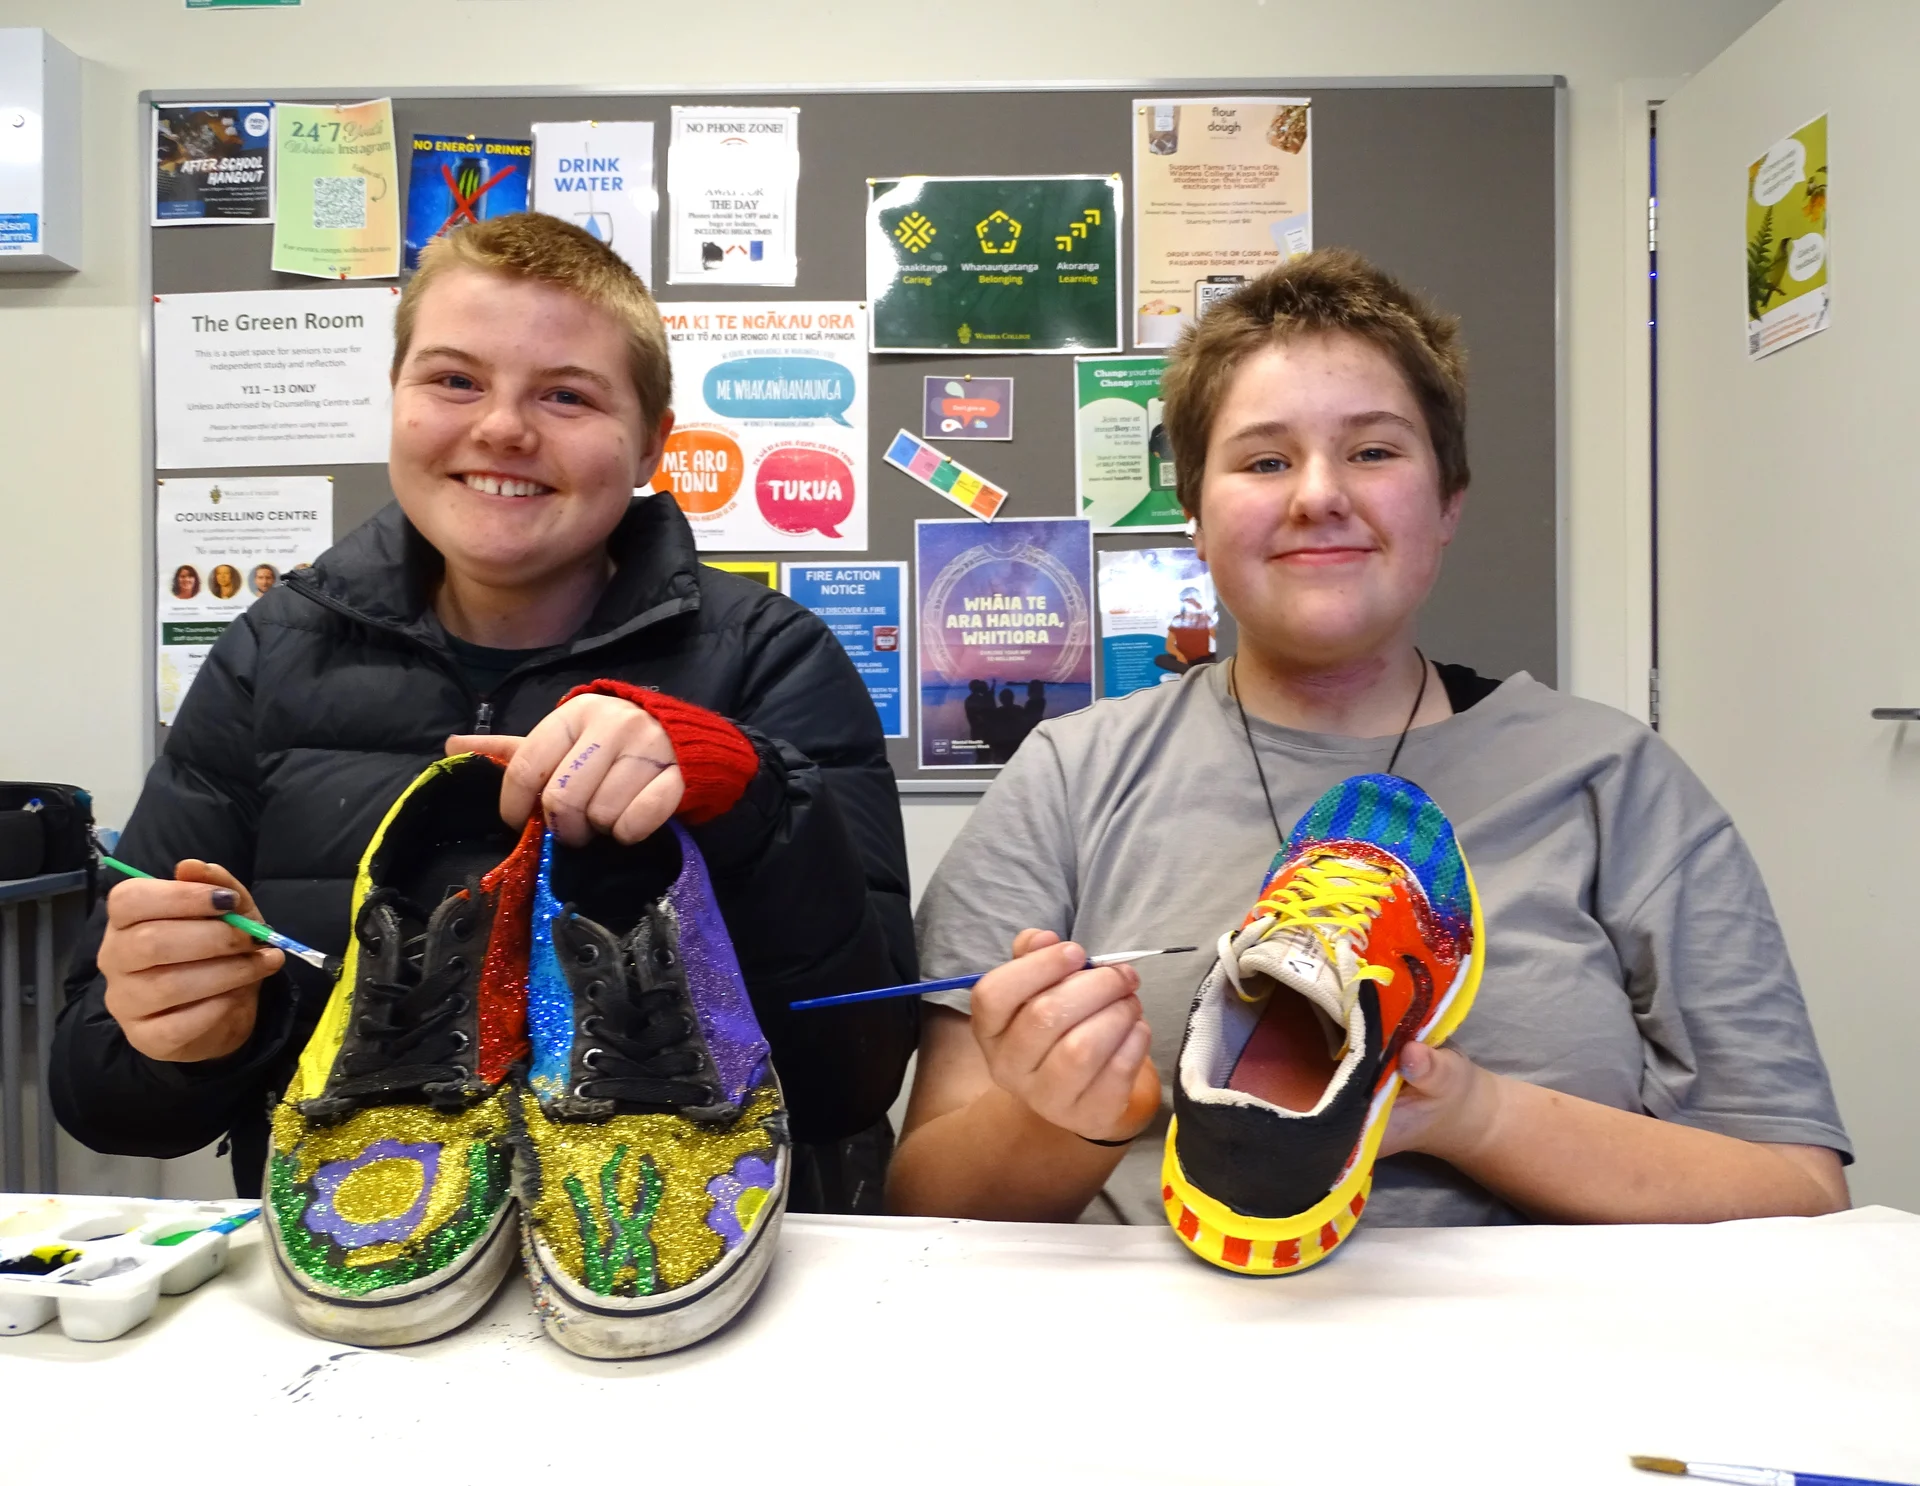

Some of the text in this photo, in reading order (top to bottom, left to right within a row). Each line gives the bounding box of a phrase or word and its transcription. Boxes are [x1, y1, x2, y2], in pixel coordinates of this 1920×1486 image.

[1211, 106, 1236, 117] flour
[686, 123, 784, 134] NO PHONE ZONE!
[1207, 121, 1241, 134] dough
[338, 141, 392, 156] Instagram
[413, 140, 531, 156] NO ENERGY DRINKS
[180, 156, 263, 175] AFTER SCHOOL
[558, 157, 621, 174] DRINK
[206, 170, 264, 186] HANGOUT
[554, 176, 624, 193] WATER
[710, 200, 760, 210] THE DAY
[961, 262, 1039, 273] Whanaungatanga
[1056, 262, 1100, 272] Akoranga
[902, 274, 932, 286] Caring
[978, 274, 1023, 285] Belonging
[1058, 274, 1098, 285] Learning
[192, 312, 364, 333] The Green Room
[693, 315, 710, 330] KI
[715, 314, 738, 329] TE
[742, 311, 813, 330] NGĀKAU
[818, 314, 855, 329] ORA
[194, 349, 212, 357] This
[229, 349, 250, 358] quiet
[252, 349, 276, 358] space
[292, 347, 321, 355] seniors
[209, 362, 262, 371] independent
[263, 361, 286, 369] study
[287, 360, 304, 368] and
[1093, 369, 1147, 379] Change your
[241, 384, 317, 395] Y11 13 ONLY
[717, 379, 842, 400] ME WHAKAWHANAUNGA
[1100, 379, 1156, 388] Change your
[187, 402, 214, 410] Unless
[273, 399, 321, 408] Counselling
[662, 450, 727, 473] ME ARO
[670, 471, 718, 493] TONU
[768, 480, 843, 502] TUKUA
[175, 510, 319, 522] COUNSELLING CENTRE
[805, 570, 881, 581] FIRE ACTION
[821, 584, 866, 596] NOTICE
[963, 593, 1047, 612] WHĀIA TE
[825, 606, 862, 615] DISCOVER
[862, 606, 869, 614] A
[869, 606, 886, 615] FIRE
[946, 613, 1065, 629] ARA HAUORA,
[962, 630, 1049, 645] WHITIORA
